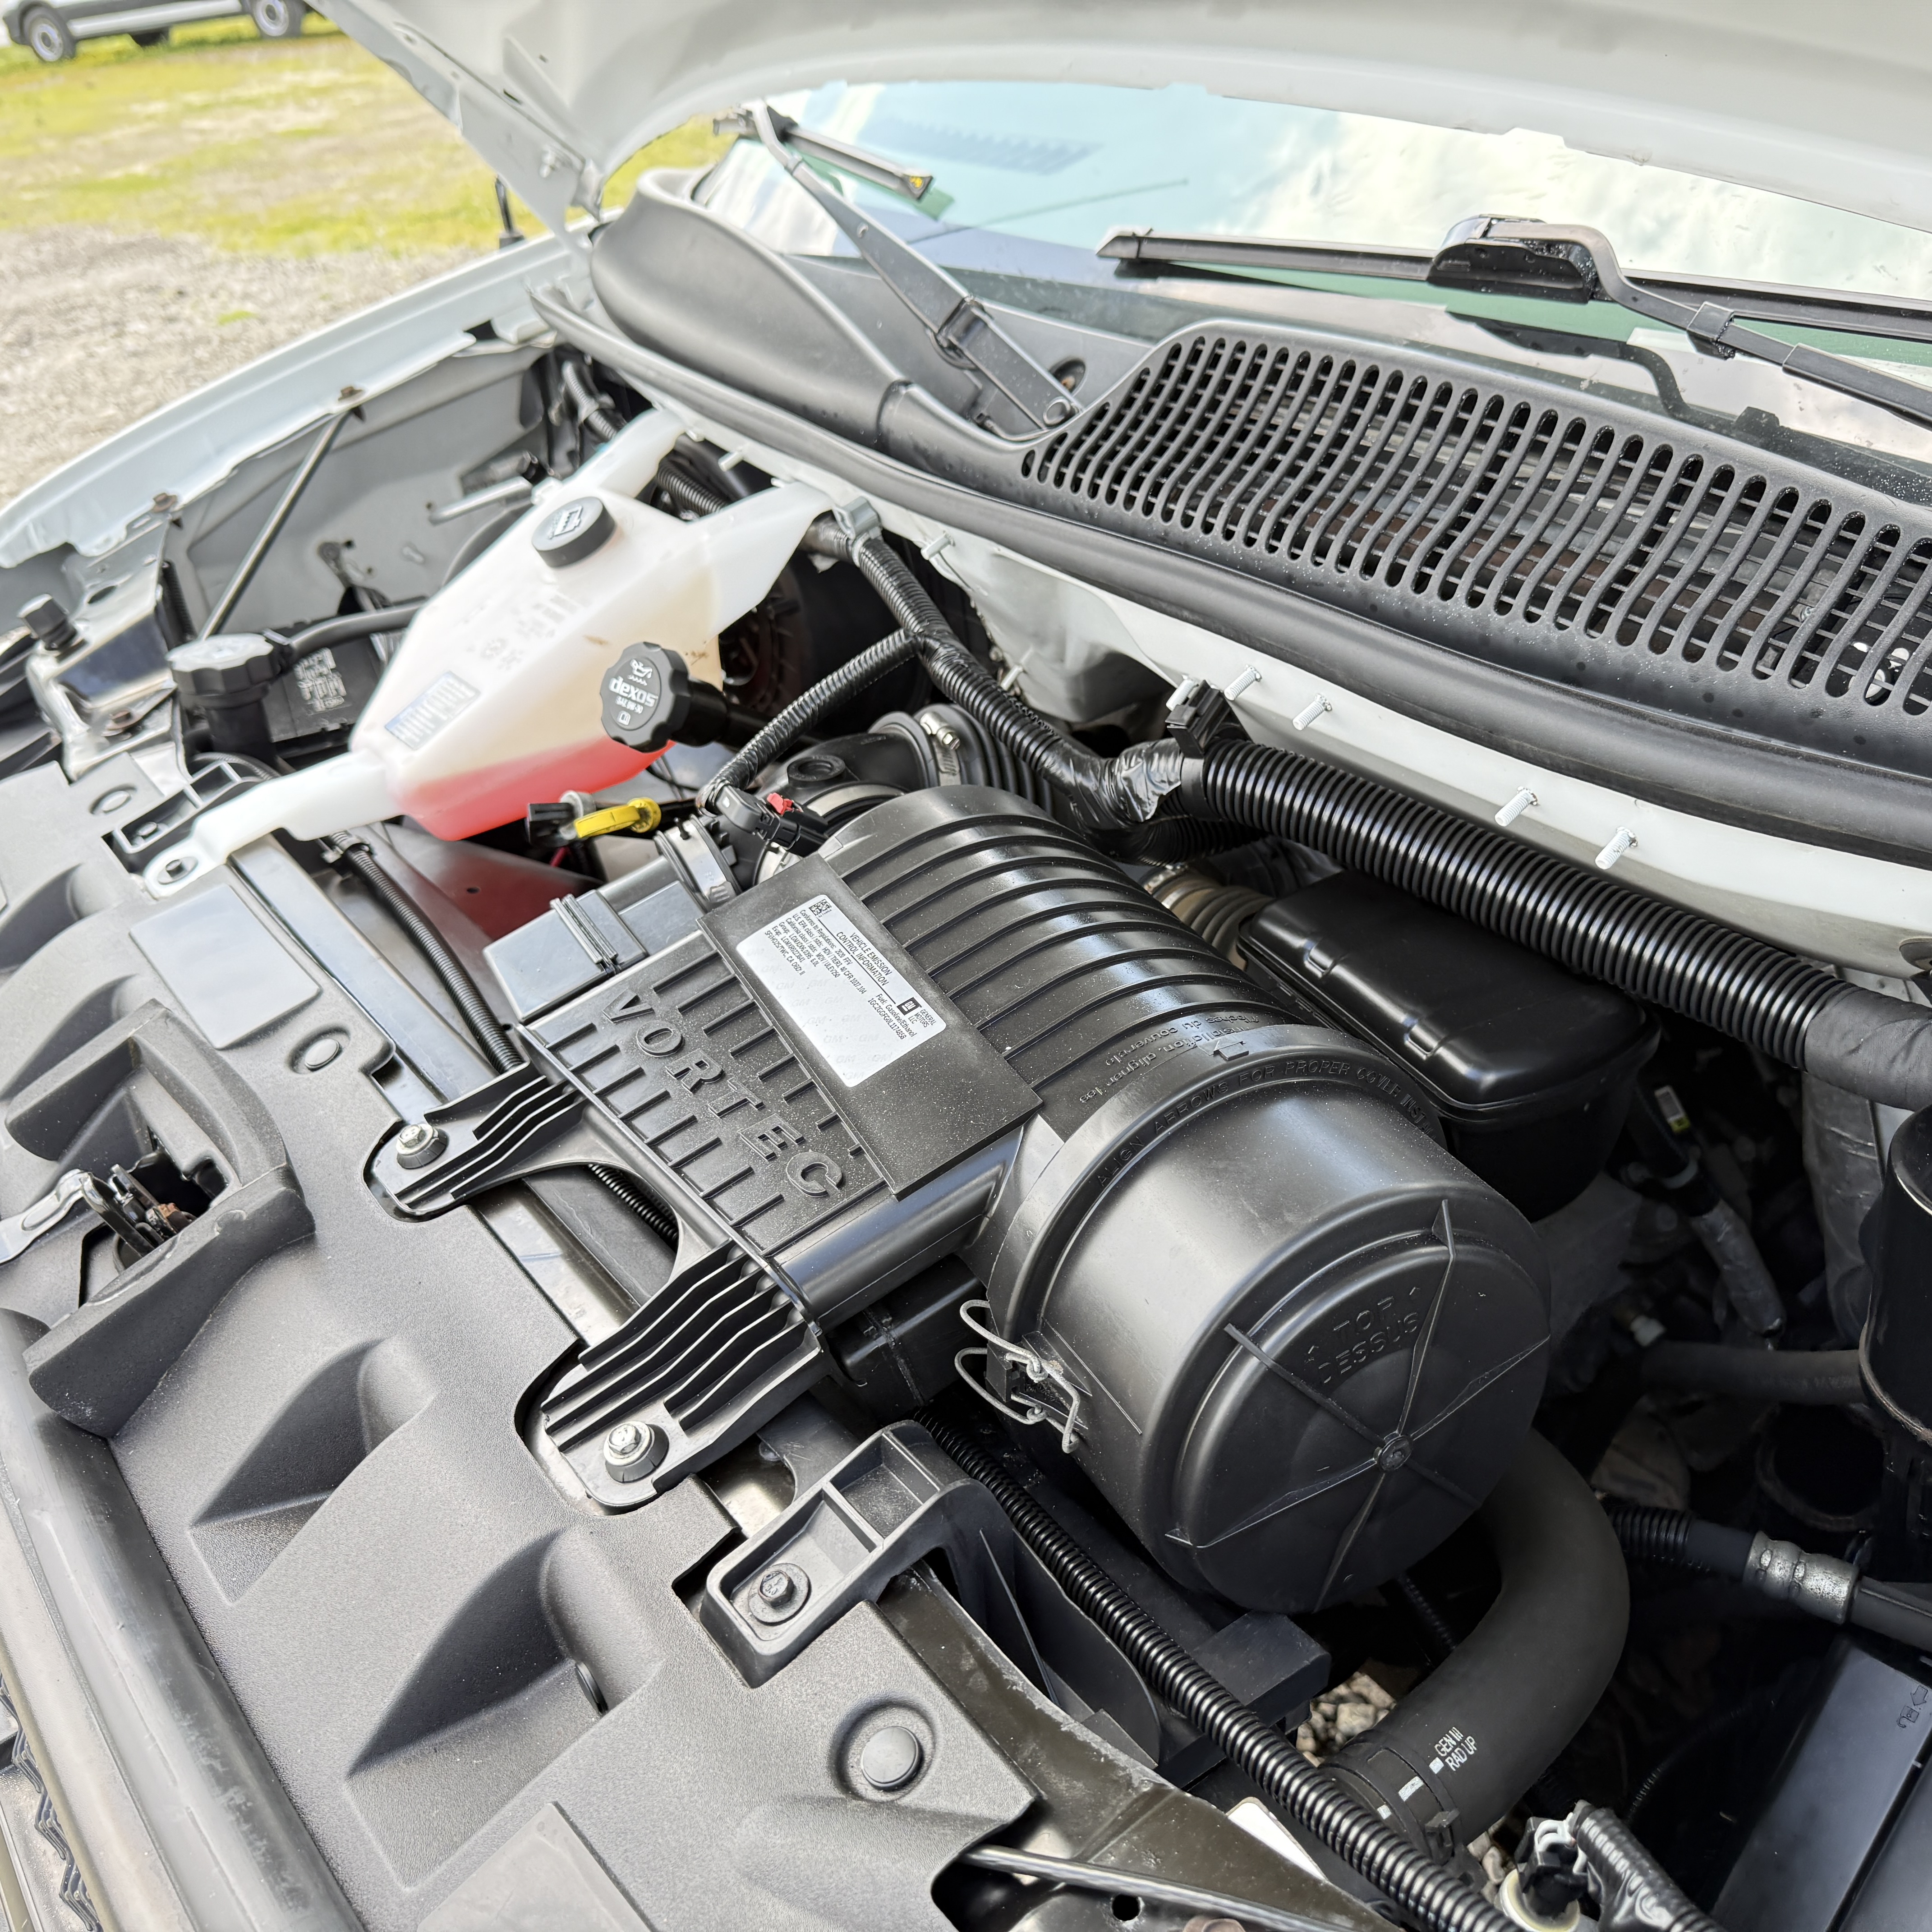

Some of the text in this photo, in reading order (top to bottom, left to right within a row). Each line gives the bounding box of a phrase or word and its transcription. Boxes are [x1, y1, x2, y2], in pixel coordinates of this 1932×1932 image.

[609, 676, 656, 707] dexos
[777, 921, 790, 934] Group:
[785, 917, 801, 935] California
[798, 933, 809, 943] class
[800, 909, 815, 926] Conforms
[834, 948, 846, 958] 2020
[842, 957, 853, 965] FFV
[798, 920, 808, 929] EPA
[804, 928, 814, 938] class
[843, 970, 854, 980] CFR
[836, 931, 889, 986] CONTROL INFORMATION
[850, 932, 892, 975] VEHICLE EMISSION
[875, 993, 917, 1037] Fuel: Gasoline/Ethanol
[908, 1015, 917, 1024] LLC
[914, 1012, 929, 1028] MOTORS
[920, 1009, 936, 1026] GENERAL
[1182, 1020, 1202, 1030] du
[603, 988, 846, 1197] VORTEC
[1097, 1136, 1145, 1187] ALIGN
[1153, 1082, 1229, 1135] ARROWS
[1238, 1064, 1275, 1086] FOR
[1285, 1060, 1350, 1076] PROPER
[1356, 1067, 1403, 1098] COVER
[1333, 1296, 1395, 1341] TOP
[1435, 1726, 1464, 1756] GEN III
[1445, 1736, 1477, 1771] RAD UP
